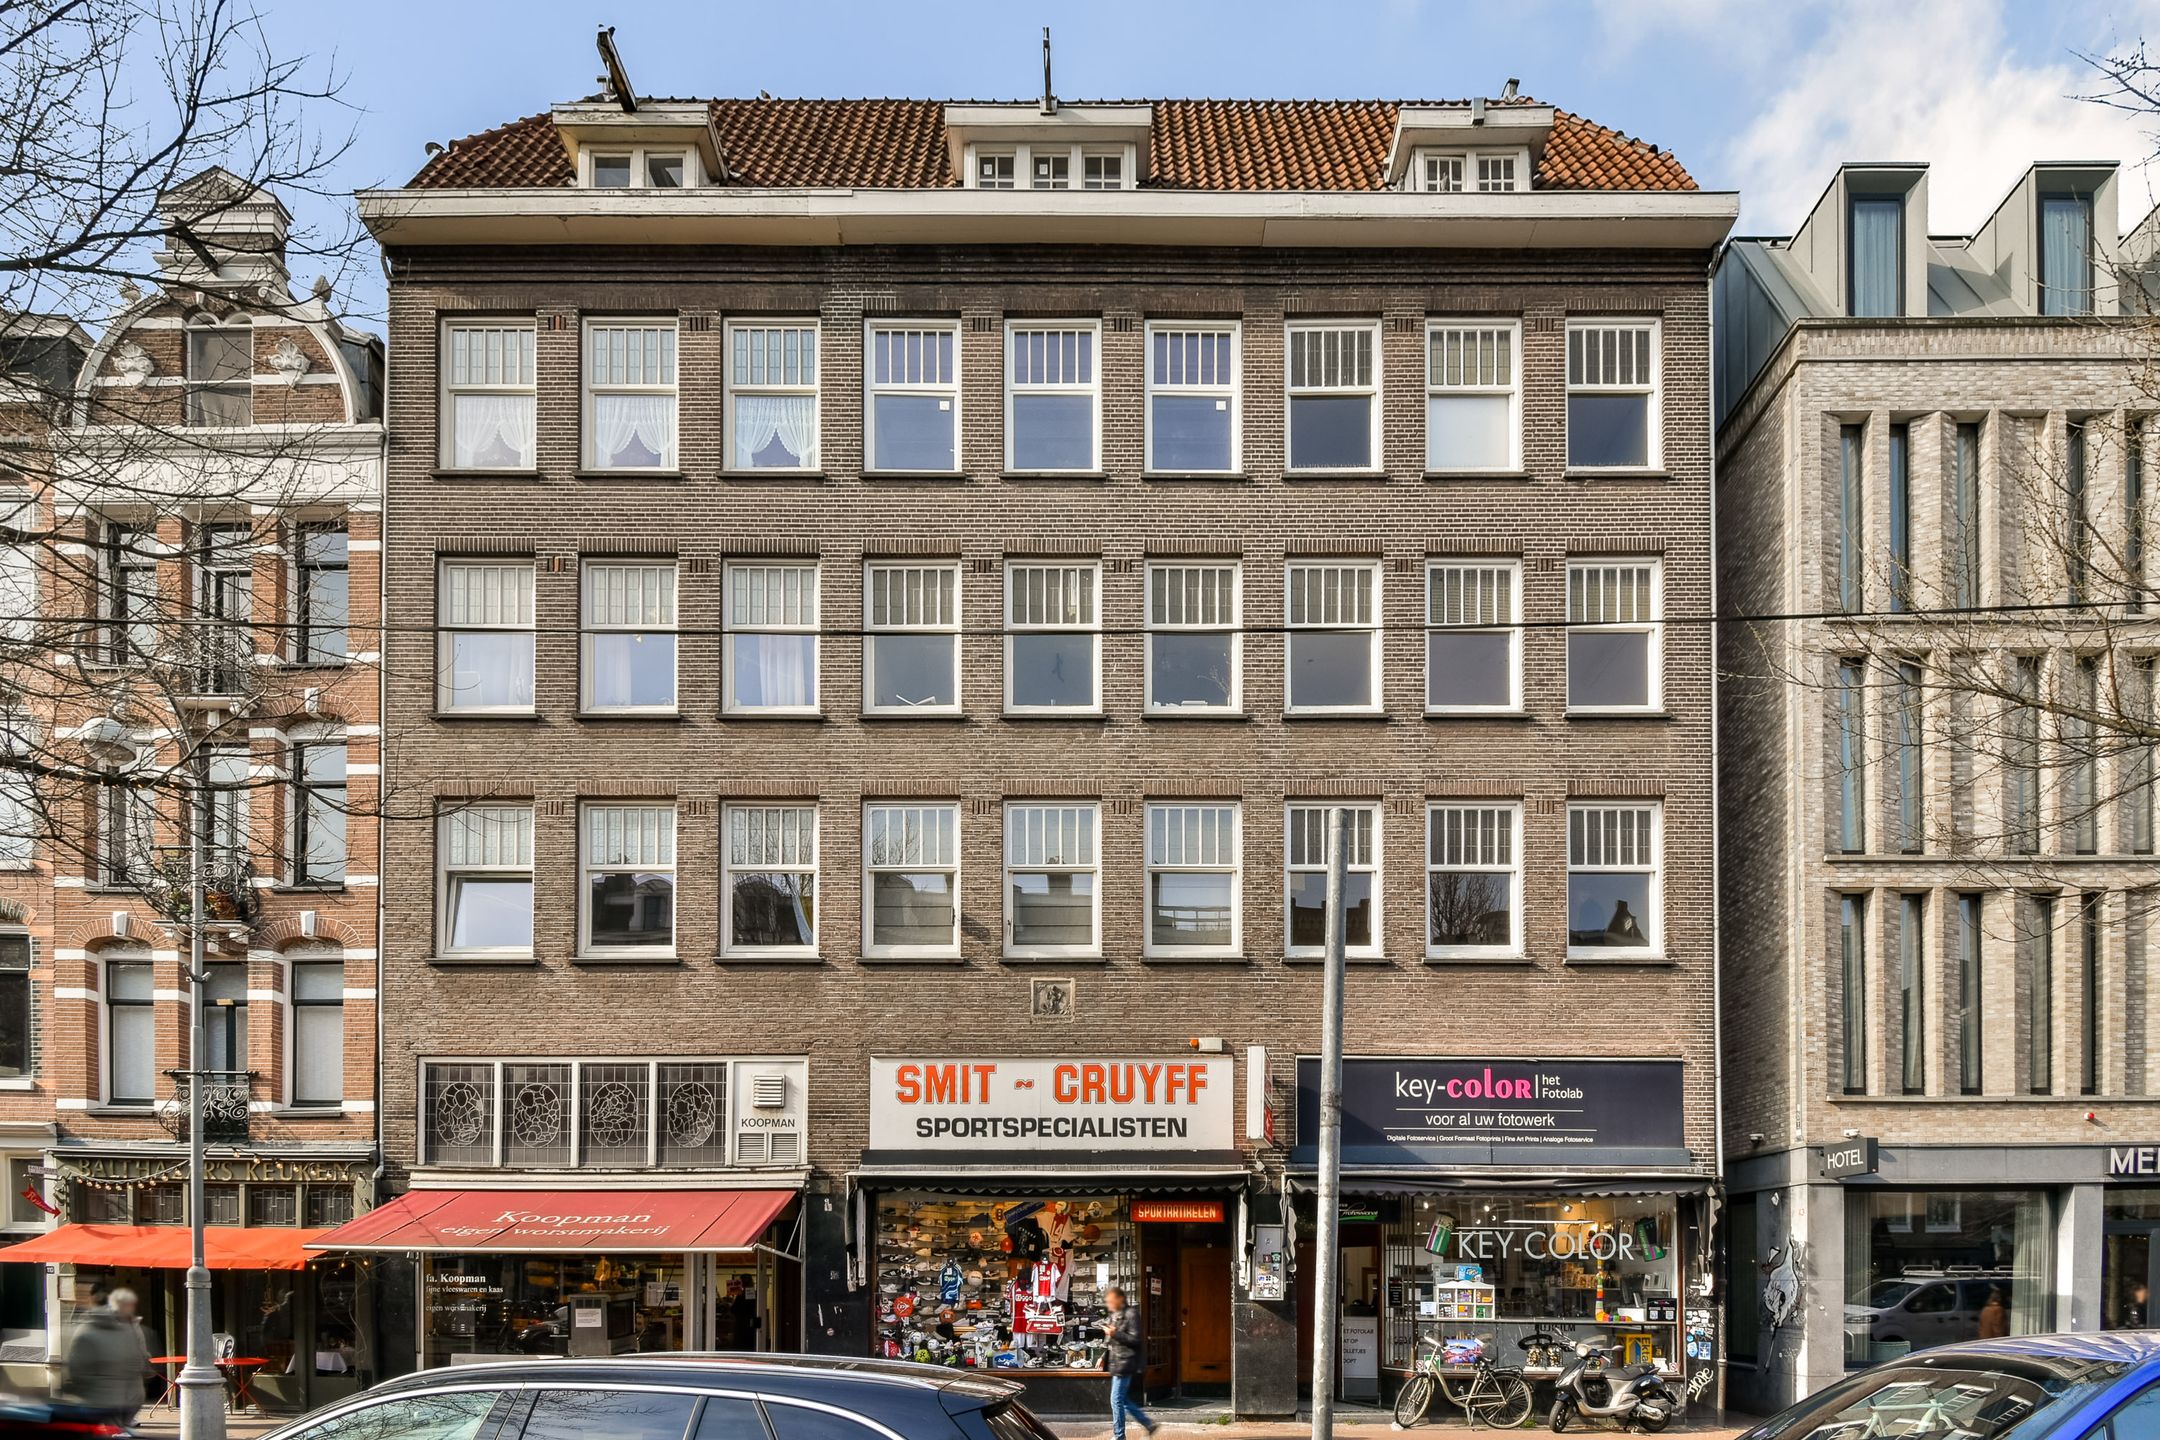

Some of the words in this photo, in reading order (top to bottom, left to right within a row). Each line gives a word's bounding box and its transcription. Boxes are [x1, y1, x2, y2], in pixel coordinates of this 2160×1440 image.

[895, 1062, 997, 1105] SMIT
[1053, 1062, 1208, 1105] CRUYFF
[1542, 1074, 1561, 1086] het
[1542, 1088, 1584, 1099] Fotolab
[741, 1118, 796, 1128] KOOPMAN
[1425, 1114, 1455, 1126] voor
[1458, 1113, 1470, 1126] al
[1475, 1114, 1494, 1126] uw
[1498, 1113, 1555, 1127] fotowerk
[916, 1117, 1187, 1138] SPORTSPECIALISTEN
[1827, 1148, 1863, 1169] HOTEL
[79, 1159, 233, 1181] BALTHAZR'S
[246, 1160, 350, 1182] KEUKEN
[492, 1210, 652, 1227] Koopman
[1138, 1205, 1217, 1219] SPORTARTIKELEN
[440, 1225, 504, 1237] eigen
[513, 1225, 671, 1236] worstmakerij
[1458, 1231, 1634, 1261] KEY-COLOR
[440, 1274, 486, 1285] Koopman
